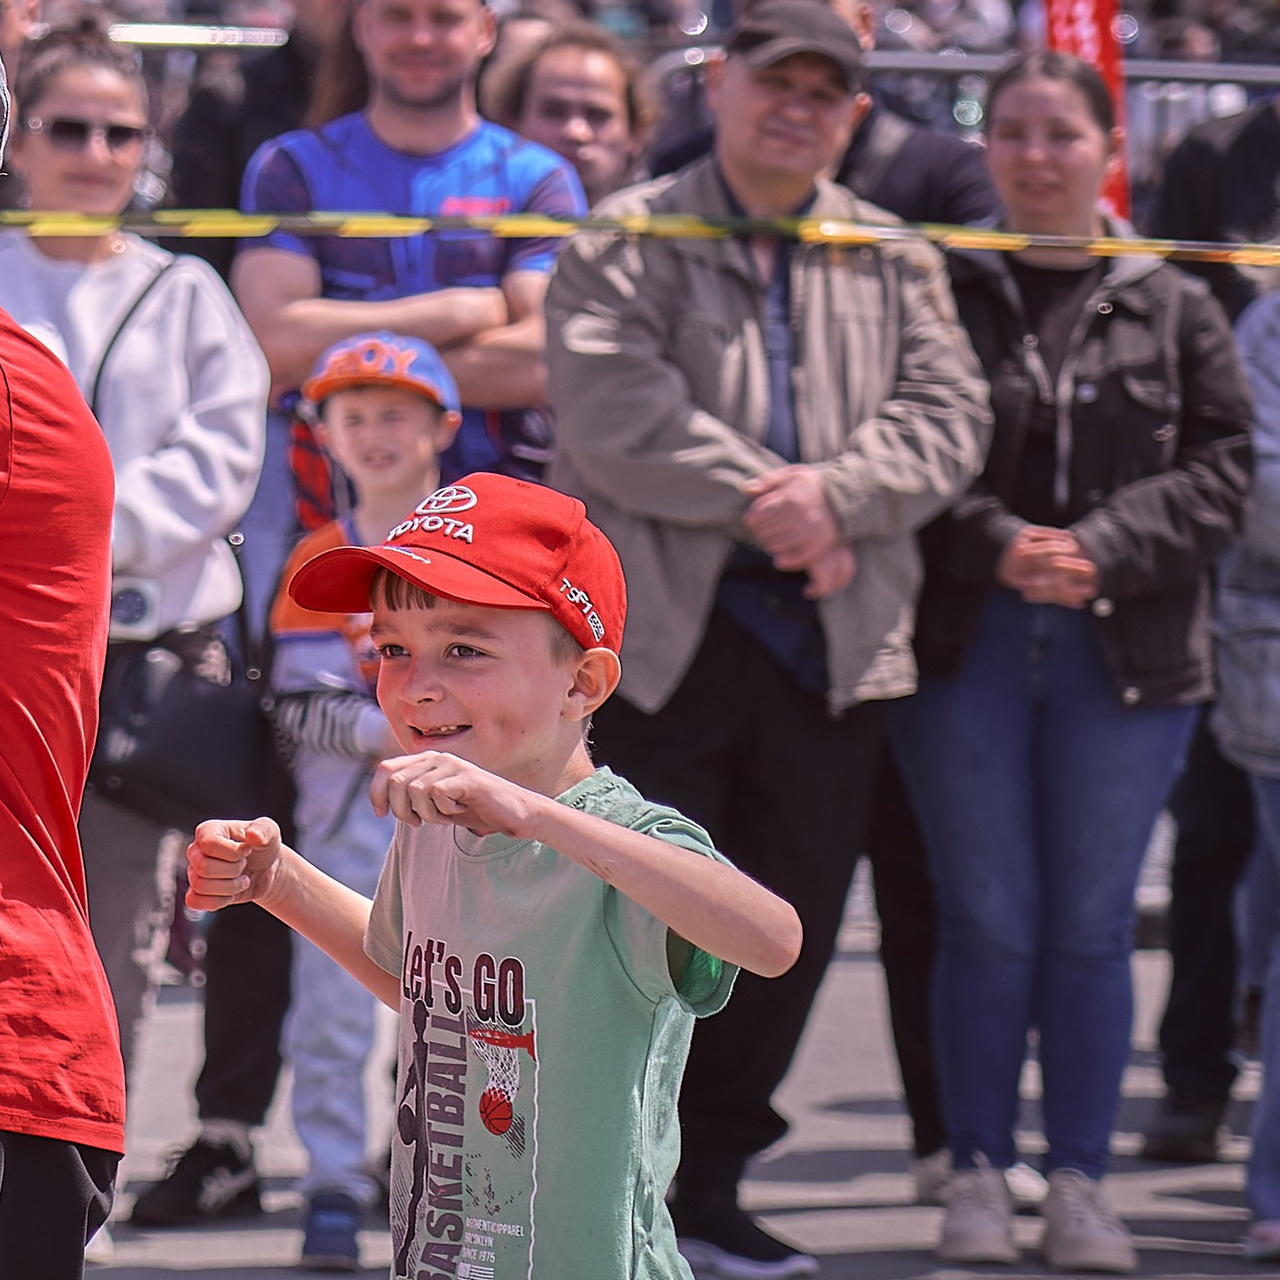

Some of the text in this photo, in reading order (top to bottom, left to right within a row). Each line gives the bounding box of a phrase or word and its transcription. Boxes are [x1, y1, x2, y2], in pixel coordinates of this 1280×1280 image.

[387, 516, 474, 543] TOYOTA
[403, 930, 525, 1026] Let's GO
[479, 1250, 496, 1263] 1975
